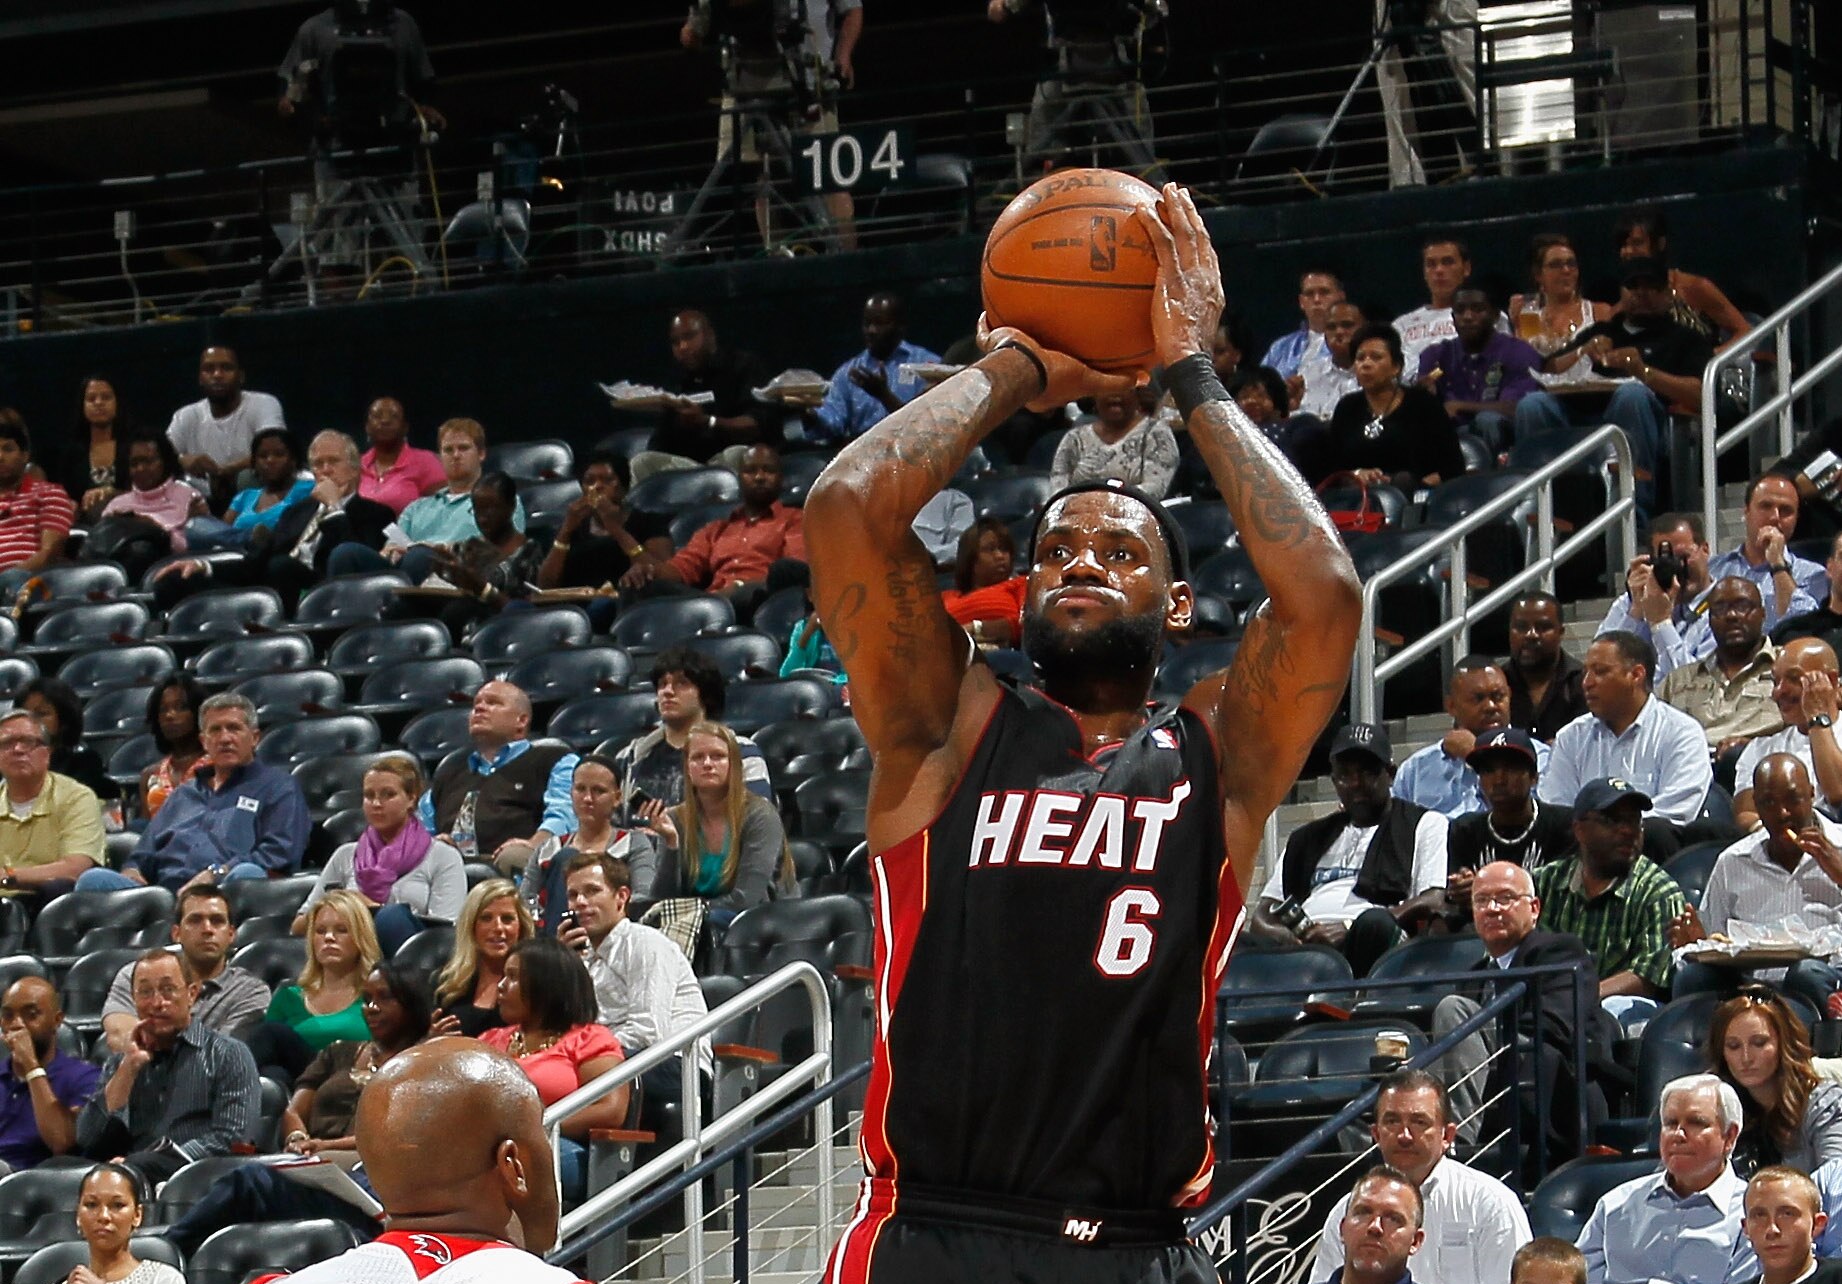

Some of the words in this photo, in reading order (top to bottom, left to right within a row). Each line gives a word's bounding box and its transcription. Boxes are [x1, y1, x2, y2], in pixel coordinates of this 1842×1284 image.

[802, 130, 904, 189] 104
[968, 779, 1192, 872] HEAT
[1093, 886, 1163, 979] 6
